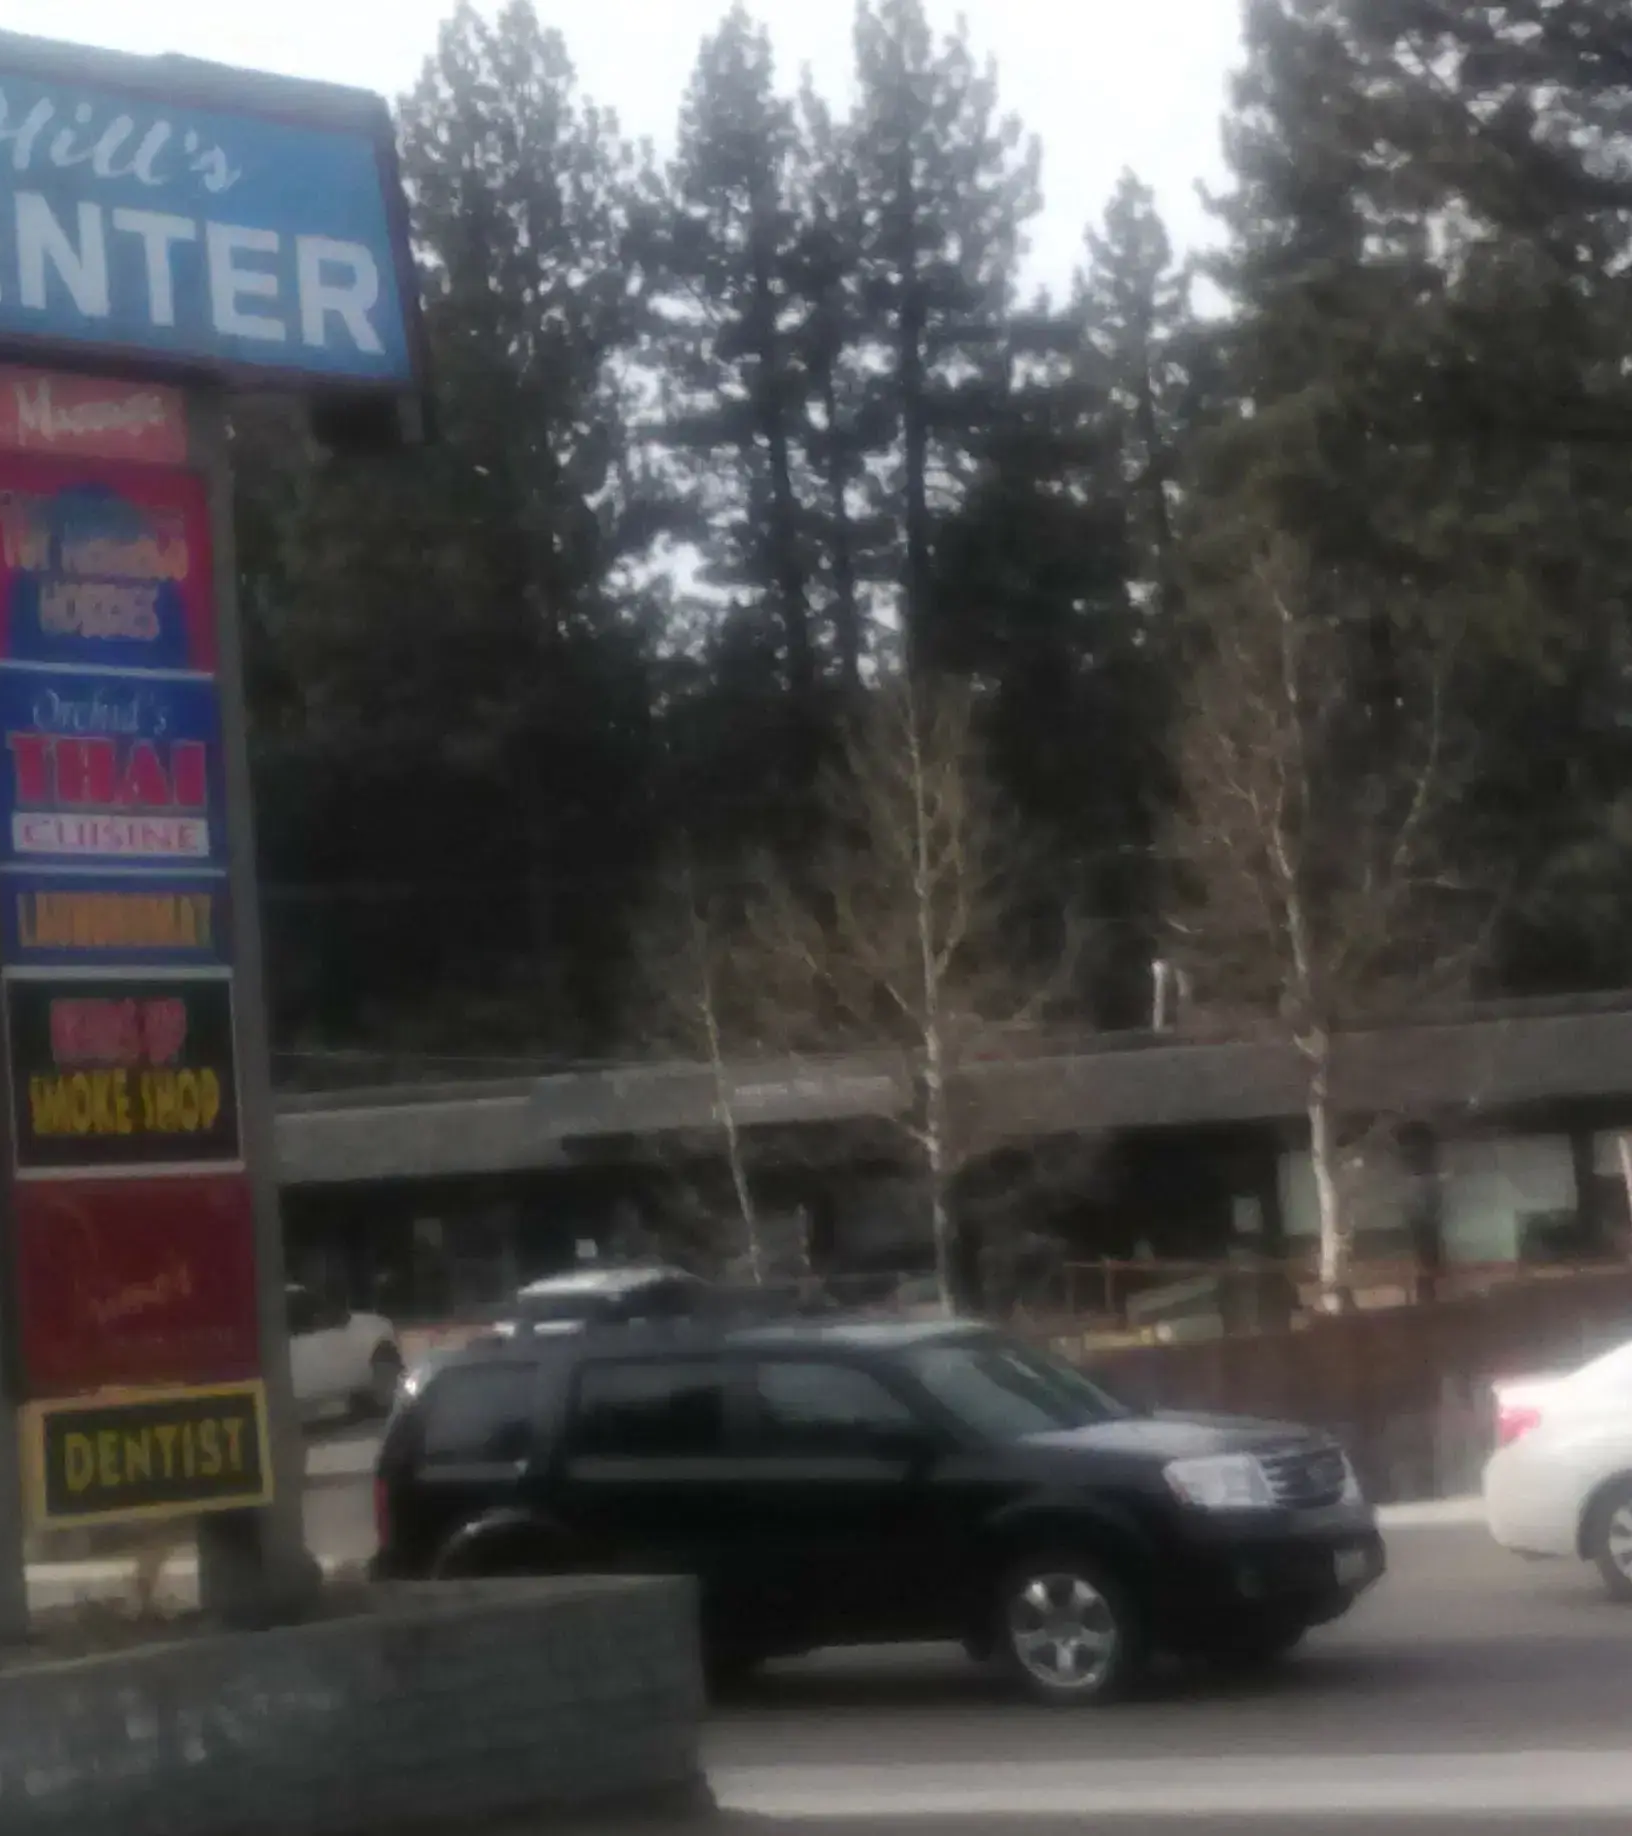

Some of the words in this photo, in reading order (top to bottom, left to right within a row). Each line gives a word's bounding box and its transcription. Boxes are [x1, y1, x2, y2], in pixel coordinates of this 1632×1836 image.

[6, 730, 208, 809] THAI
[22, 818, 201, 852] CUISINE
[63, 1415, 246, 1494] DENTIST
